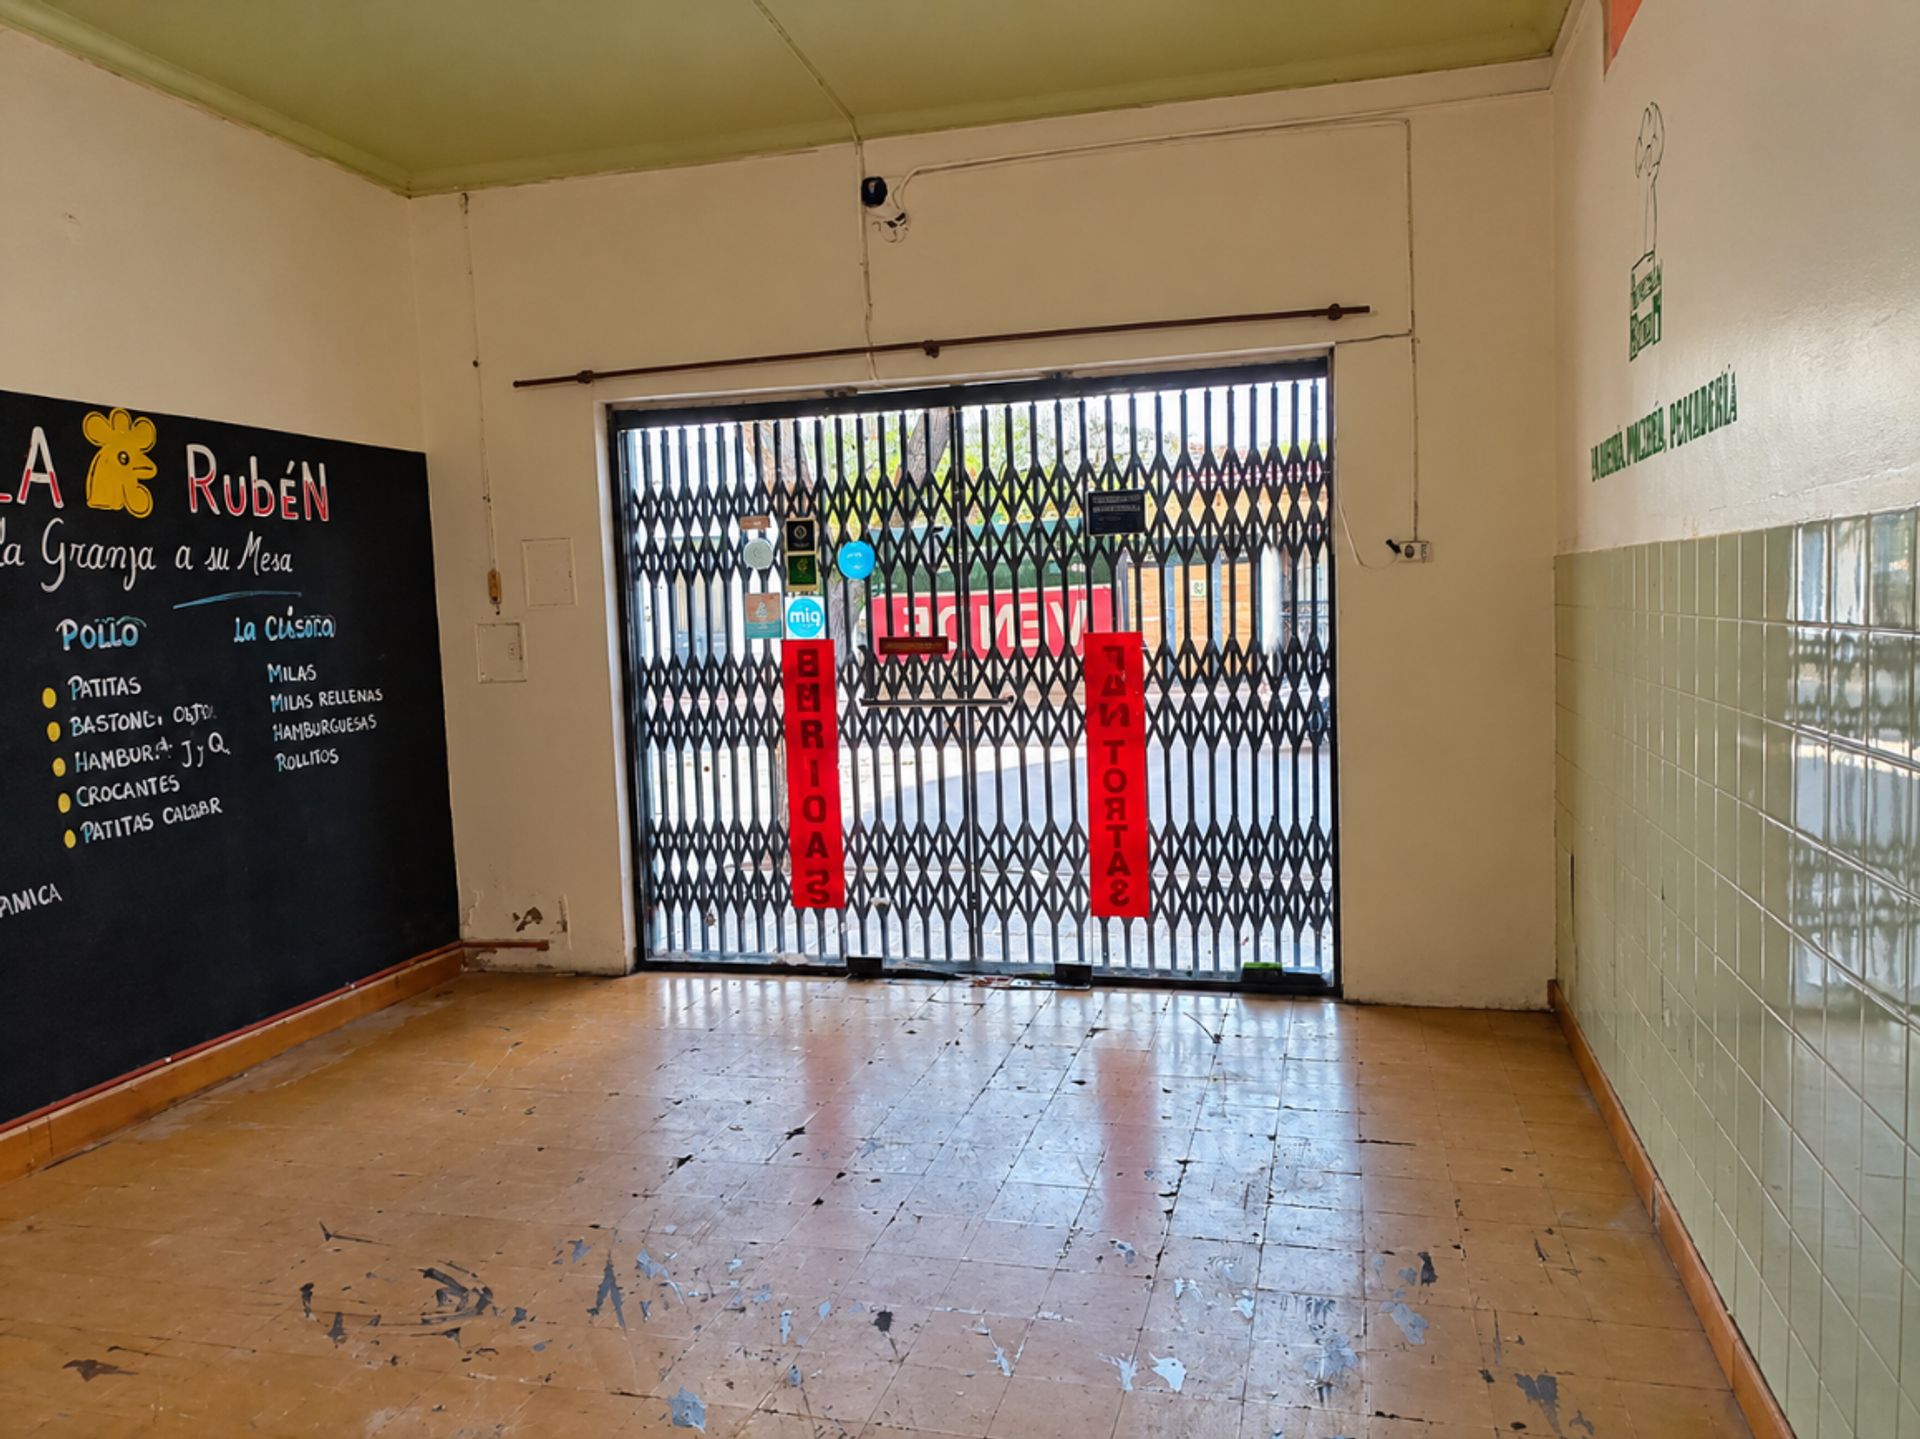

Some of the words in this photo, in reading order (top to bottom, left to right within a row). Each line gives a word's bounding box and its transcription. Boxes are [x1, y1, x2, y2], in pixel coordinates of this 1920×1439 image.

[41, 517, 157, 593] Granja
[174, 545, 194, 571] a
[204, 546, 231, 572] su
[236, 530, 294, 577] Mesa
[267, 662, 318, 684] MILAS
[67, 674, 143, 701] PATITAS
[269, 692, 314, 713] MILAS
[318, 687, 384, 708] RELLENAS
[272, 713, 378, 742] HAMBURGUESAS
[274, 747, 340, 772] ROLLITOS
[75, 773, 181, 808] CROCANTES
[79, 812, 155, 844] PATITAS
